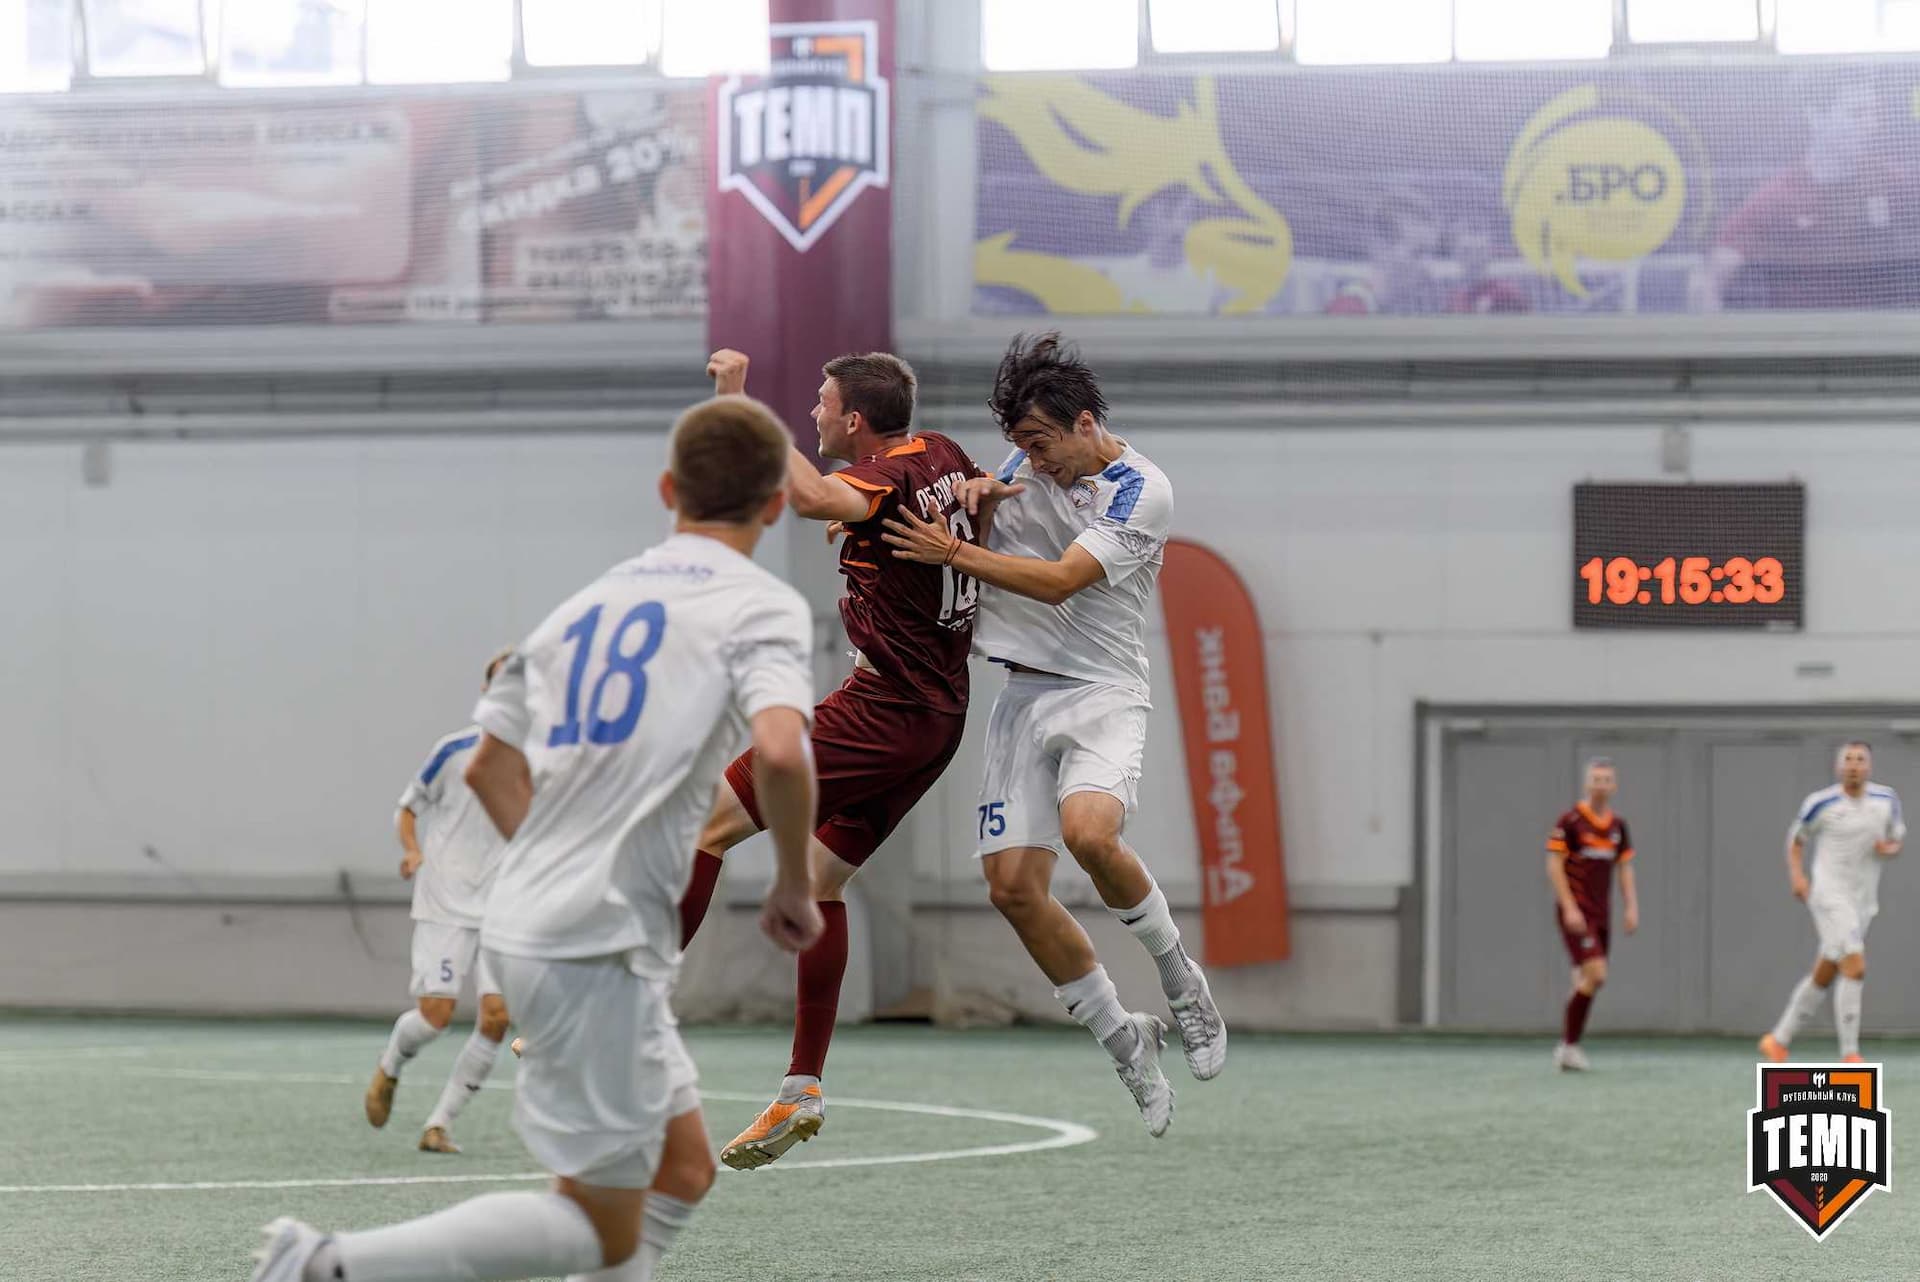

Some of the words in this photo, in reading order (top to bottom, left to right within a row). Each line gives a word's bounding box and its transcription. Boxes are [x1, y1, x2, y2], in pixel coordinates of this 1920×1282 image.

[734, 84, 871, 168] ТЕМП
[1580, 556, 1785, 605] 19:15:33
[547, 599, 667, 749] 18
[441, 959, 453, 983] 5
